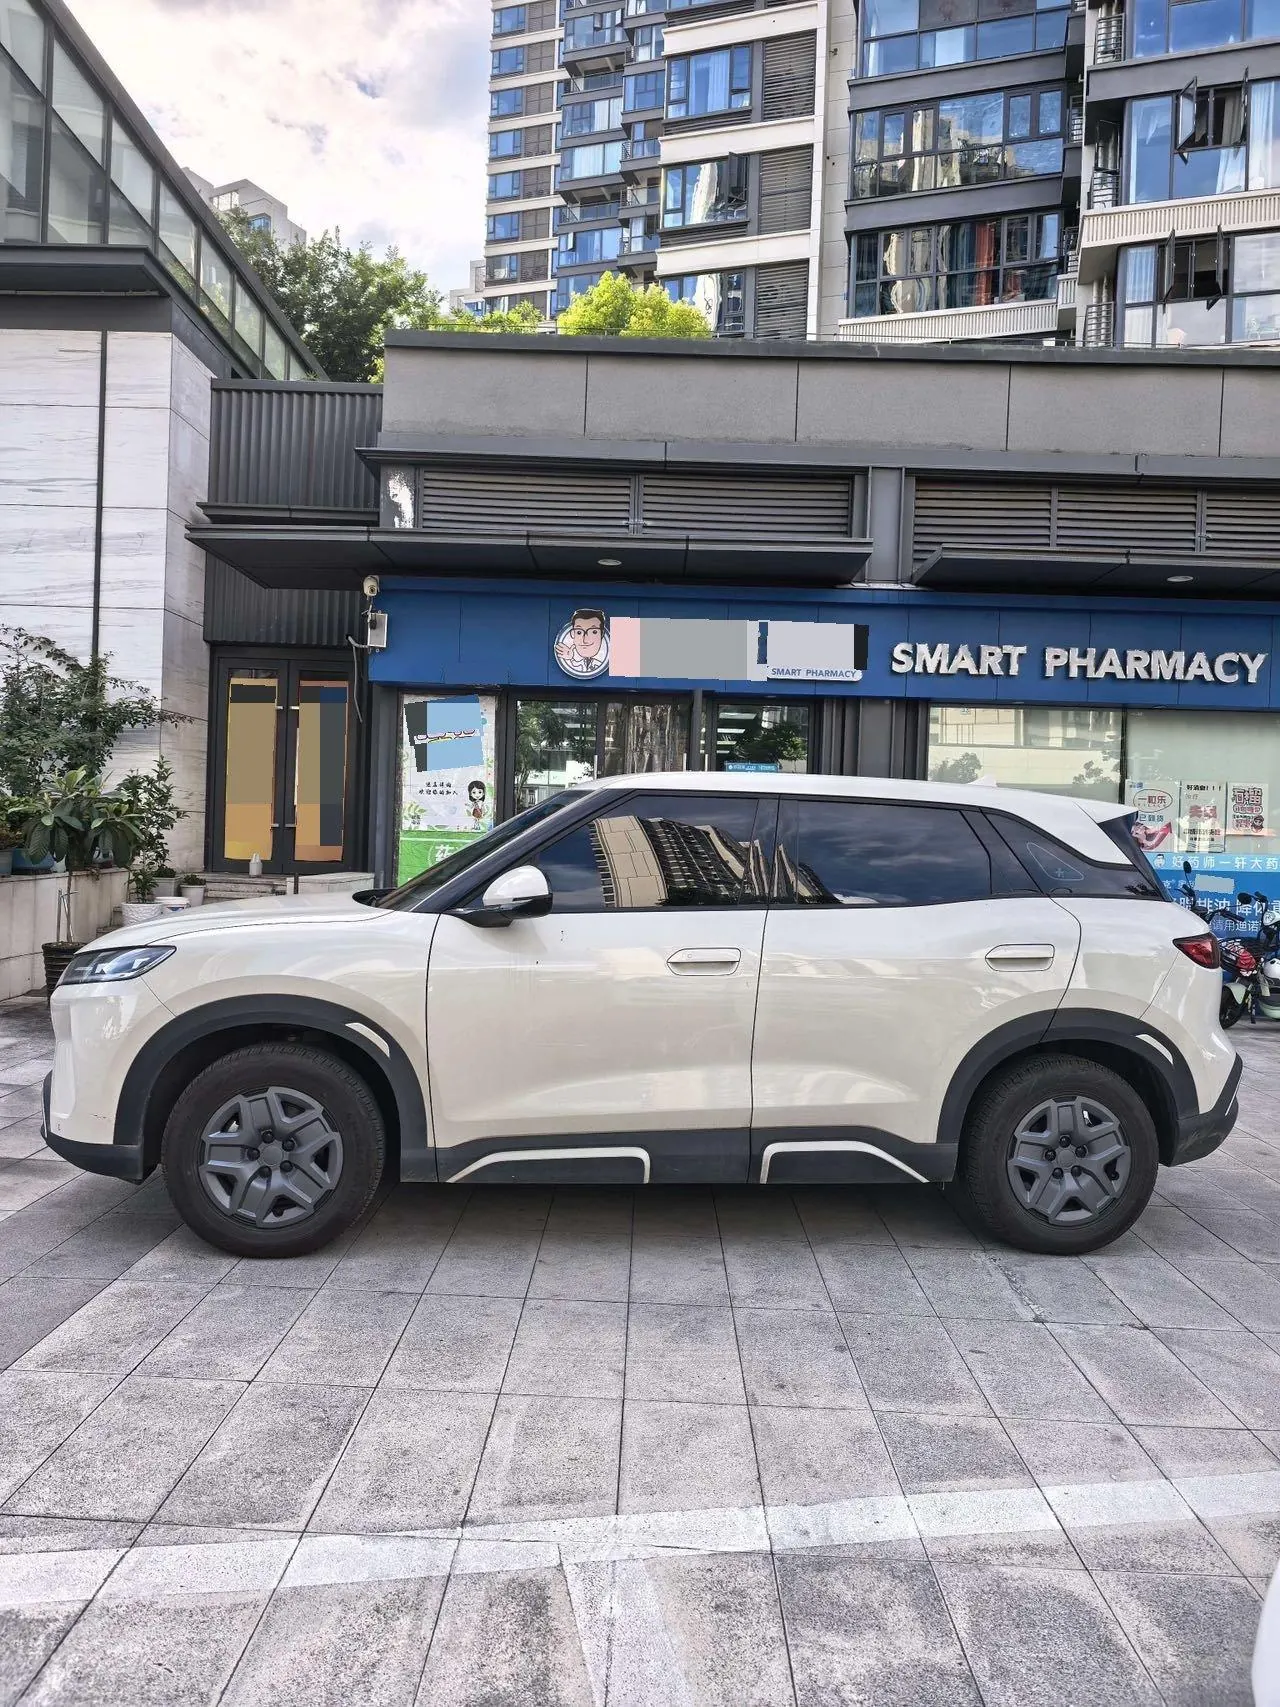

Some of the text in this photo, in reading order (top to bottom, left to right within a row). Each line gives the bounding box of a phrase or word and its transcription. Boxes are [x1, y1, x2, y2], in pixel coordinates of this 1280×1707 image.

[771, 668, 857, 678] SMART PHARMACY
[891, 642, 1269, 684] SMART PHARMACY
